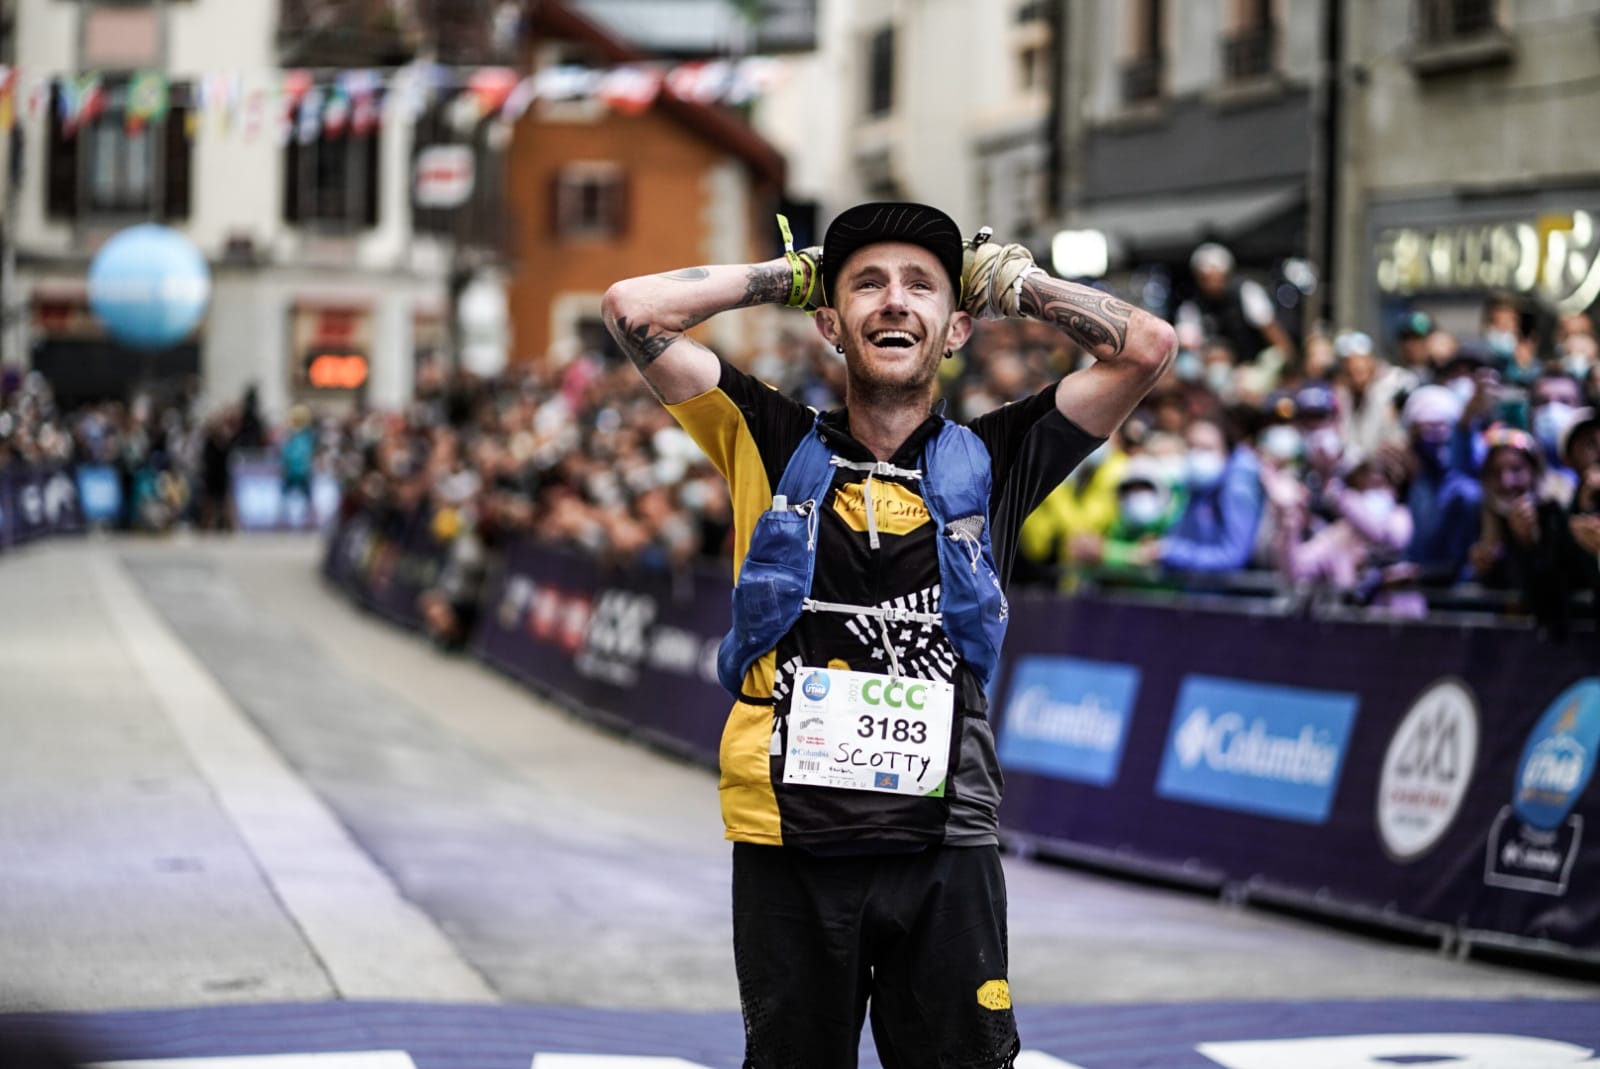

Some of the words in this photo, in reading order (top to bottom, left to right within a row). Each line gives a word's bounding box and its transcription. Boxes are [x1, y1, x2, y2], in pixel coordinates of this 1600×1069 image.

[861, 679, 927, 710] CCC
[857, 715, 927, 744] 3183
[834, 743, 930, 782] SCOTTY
[1206, 712, 1338, 786] Columbia
